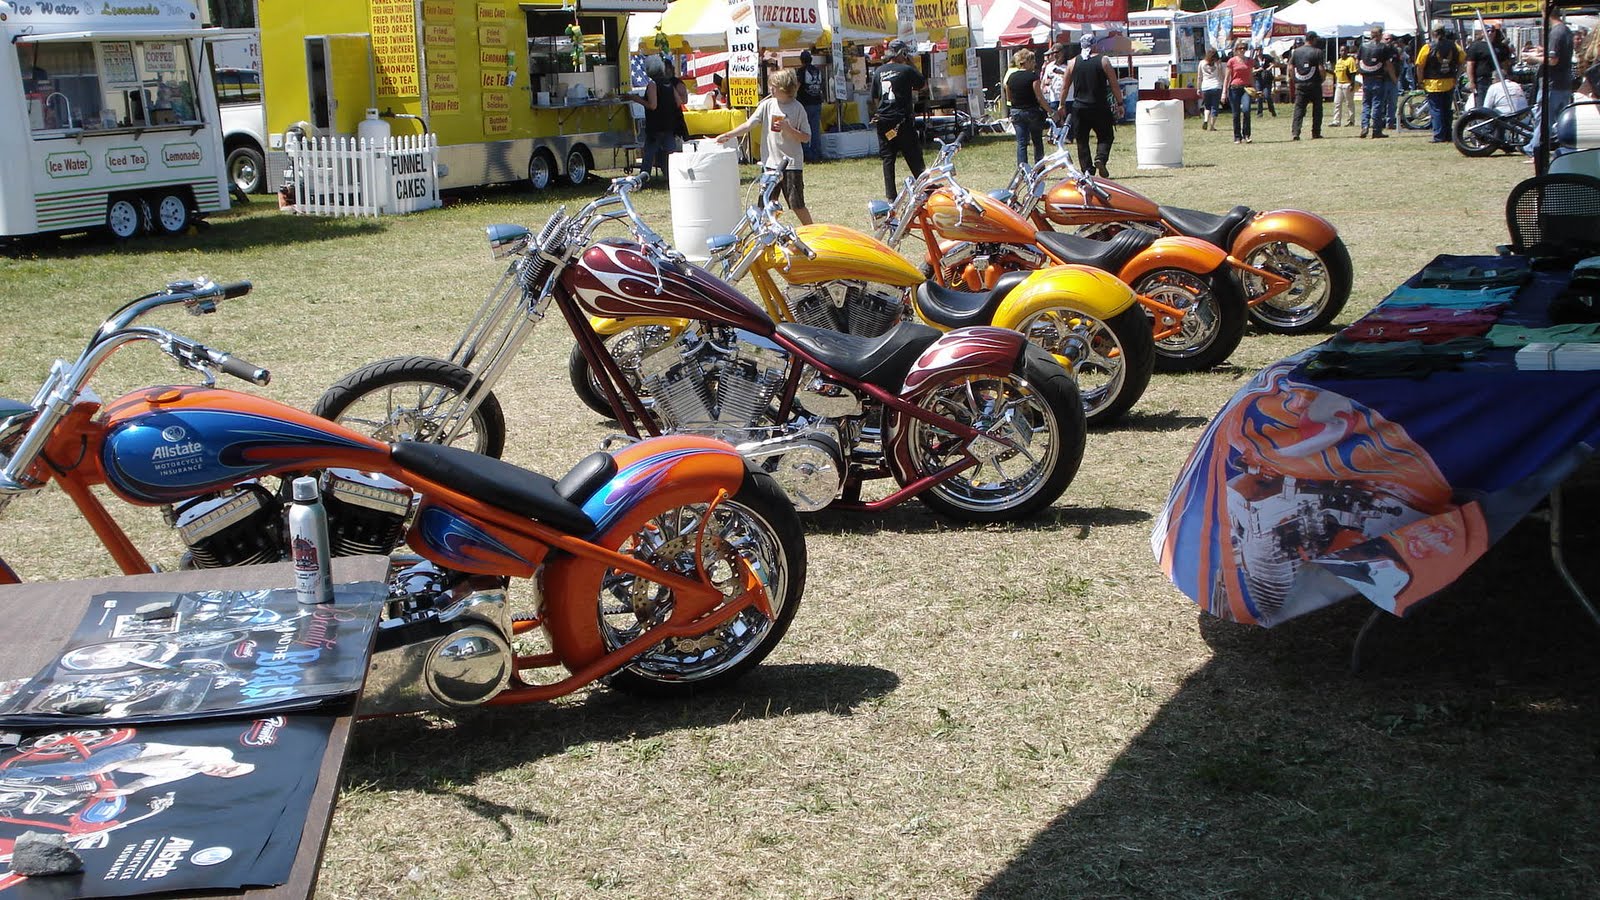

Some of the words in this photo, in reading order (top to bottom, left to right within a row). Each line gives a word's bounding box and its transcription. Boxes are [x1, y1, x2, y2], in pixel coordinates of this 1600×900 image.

[8, 1, 33, 15] Ice
[36, 1, 80, 15] Water
[100, 1, 160, 16] Lemonade
[940, 0, 959, 16] LEGS
[372, 15, 389, 24] FRIED
[390, 14, 413, 23] PICKLES
[762, 5, 817, 24] PRETZELS
[846, 3, 887, 30] NACHOS
[373, 25, 390, 34] FRIED
[391, 24, 414, 33] OREO'S
[735, 26, 750, 35] NC
[374, 35, 389, 44] FRIED
[374, 45, 389, 55] FRIED
[390, 44, 415, 54] SNICKERS
[732, 43, 755, 53] BBQ
[376, 64, 416, 74] LEMONADE
[732, 63, 755, 72] WINGS
[381, 76, 398, 86] ICED
[399, 75, 413, 85] TEA
[436, 73, 450, 82] Fried
[483, 73, 495, 86] ICE
[378, 86, 400, 96] BOTTLED
[400, 85, 419, 95] WATER
[730, 87, 757, 97] TURKEY
[736, 97, 753, 105] LEGS
[109, 155, 127, 166] Iced
[130, 154, 146, 165] Tea
[164, 149, 200, 162] Lemonade
[49, 160, 63, 172] Ice
[63, 158, 88, 171] Water
[391, 153, 427, 176] FUNNEL
[396, 178, 426, 199] CAKES
[152, 441, 203, 460] Allstate
[154, 456, 203, 470] MOTORCYCLE
[160, 464, 202, 476] INSURANCE
[272, 645, 289, 660] THE
[103, 843, 138, 880] INSURANCE
[119, 839, 156, 881] MOTORCYCLE
[142, 836, 194, 881] Allstate
